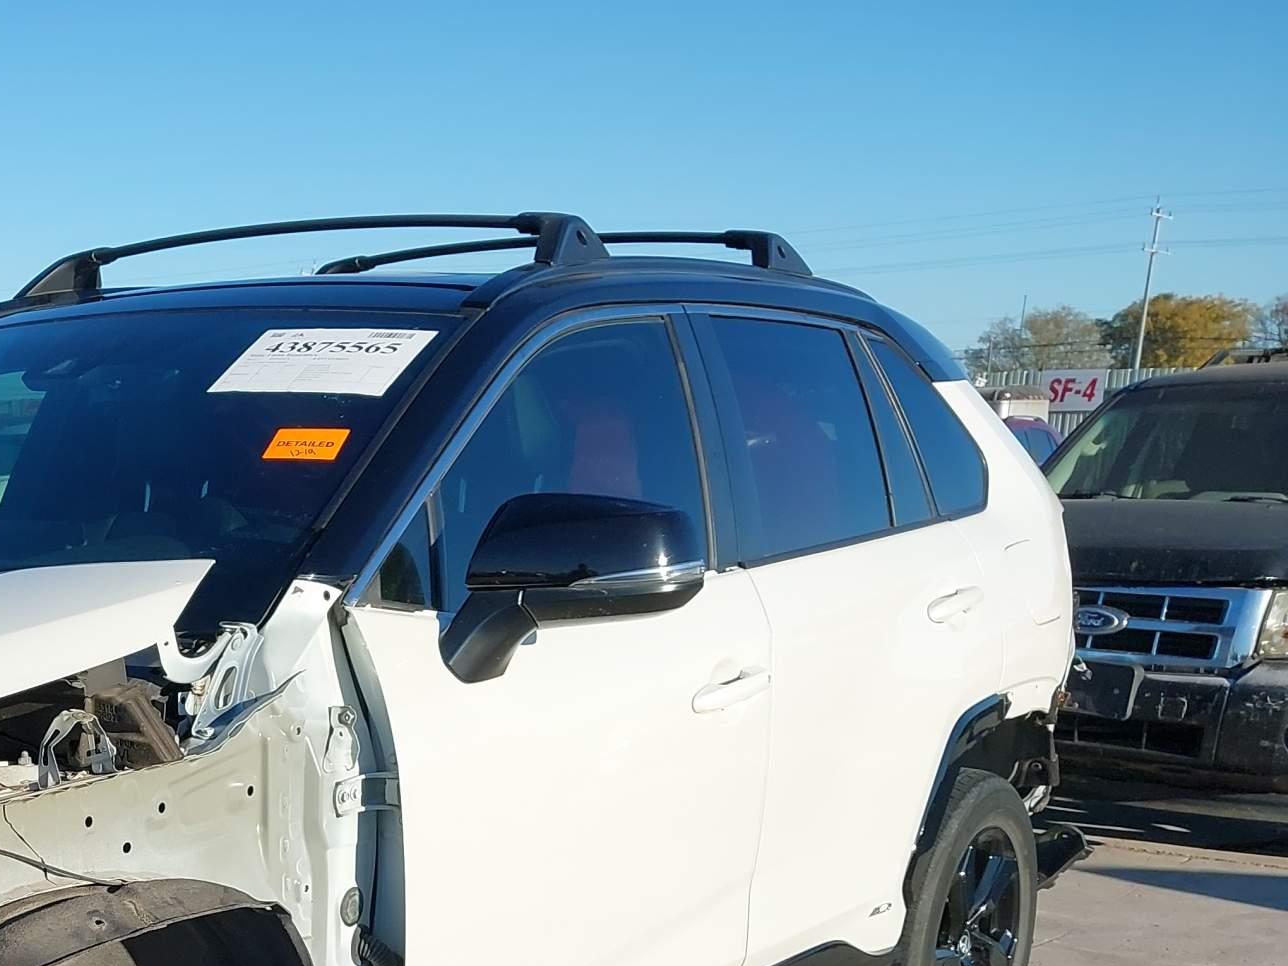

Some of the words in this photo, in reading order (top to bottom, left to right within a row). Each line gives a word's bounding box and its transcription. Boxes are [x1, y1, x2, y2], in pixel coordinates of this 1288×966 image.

[265, 341, 403, 354] 43875565
[1049, 378, 1098, 402] SF-4
[276, 440, 335, 448] DETAILED
